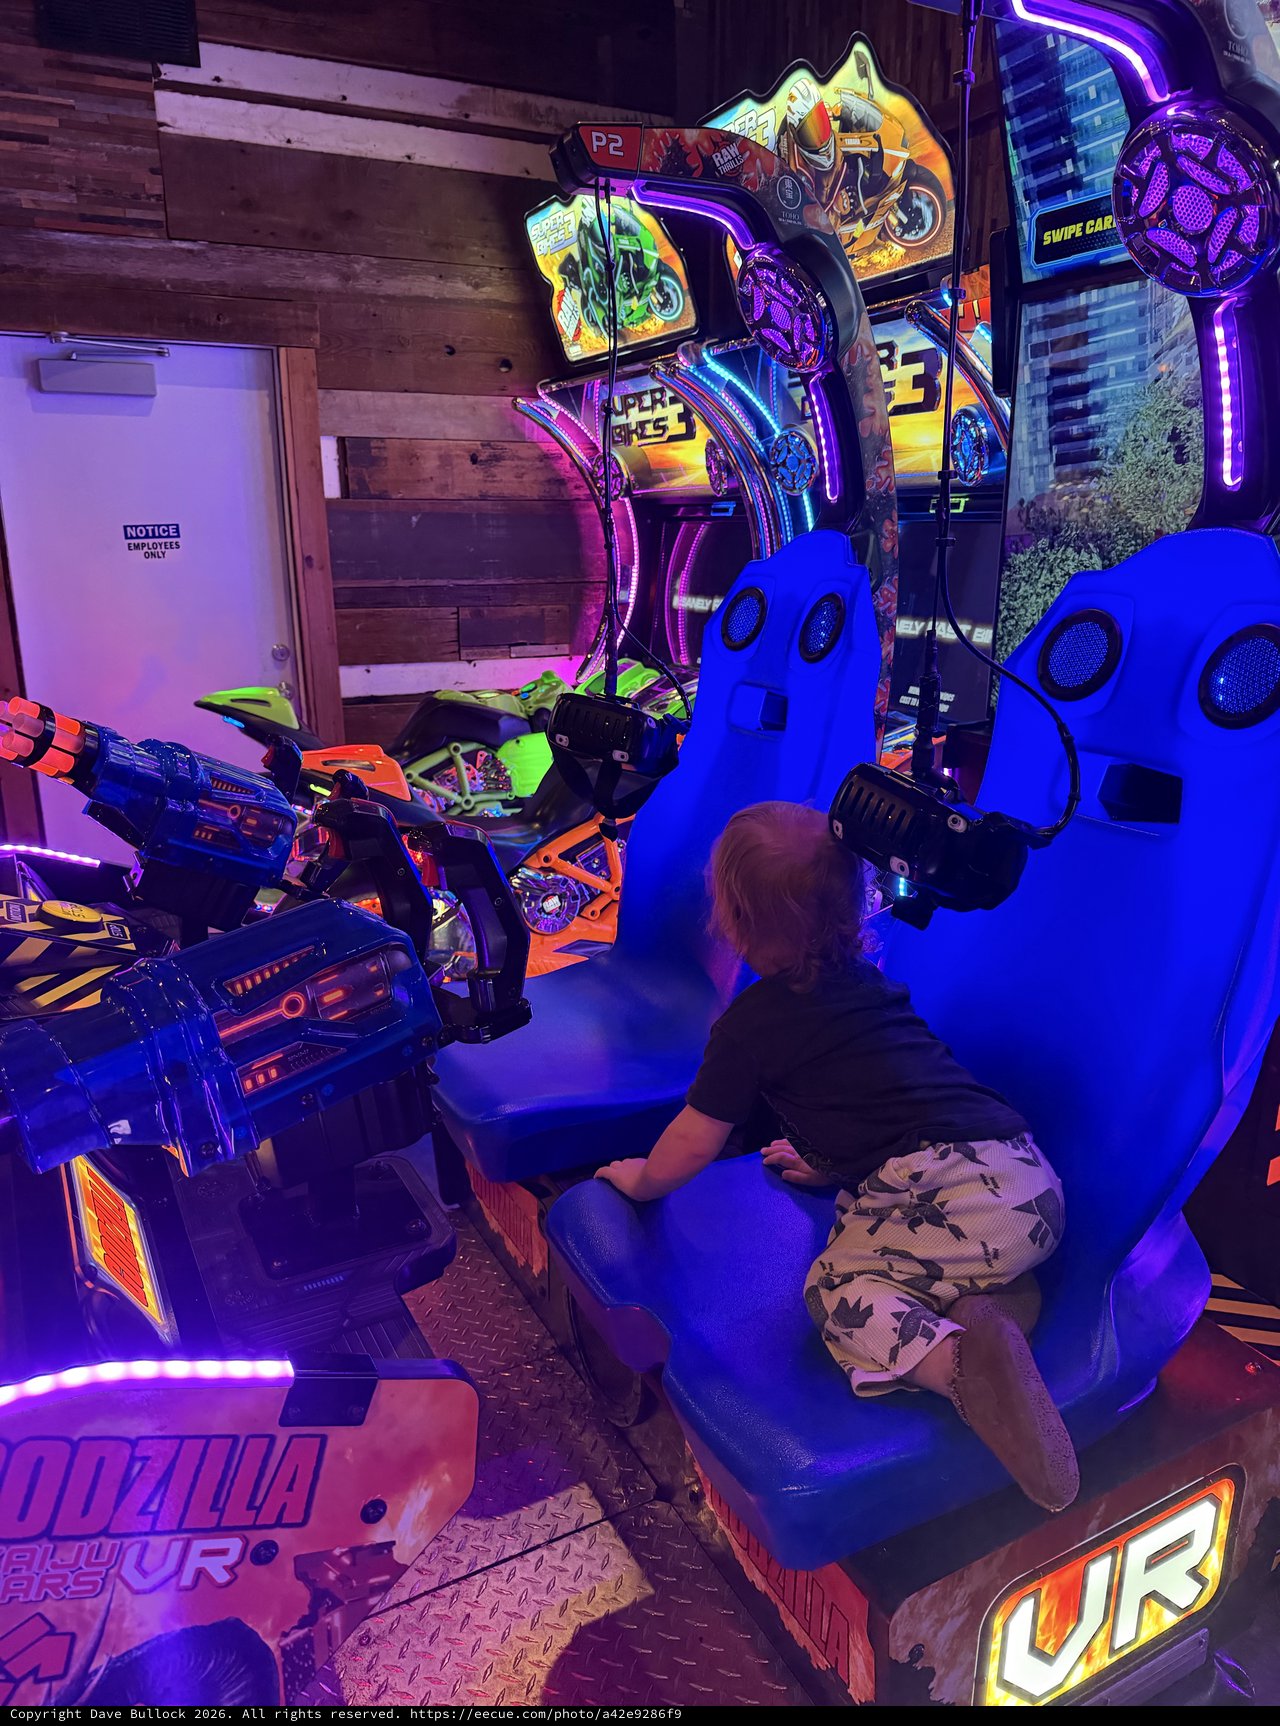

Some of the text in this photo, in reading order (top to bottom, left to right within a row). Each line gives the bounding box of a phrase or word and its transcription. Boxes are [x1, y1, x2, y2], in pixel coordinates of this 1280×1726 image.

[591, 131, 624, 157] P2
[712, 142, 740, 167] RAW
[717, 155, 744, 176] THRILLS
[530, 210, 564, 241] SUPER
[1043, 222, 1084, 246] SWIPE
[536, 229, 566, 256] BIKES
[890, 347, 943, 416] 3
[126, 525, 178, 538] NOTICE
[127, 541, 180, 551] EMPLOYEES
[143, 550, 166, 559] ONLY
[0, 1434, 327, 1541] ODZILLA
[0, 1541, 122, 1574] AIJU
[119, 1534, 248, 1594] VR
[0, 1568, 107, 1604] ARS
[999, 1494, 1220, 1698] VR
